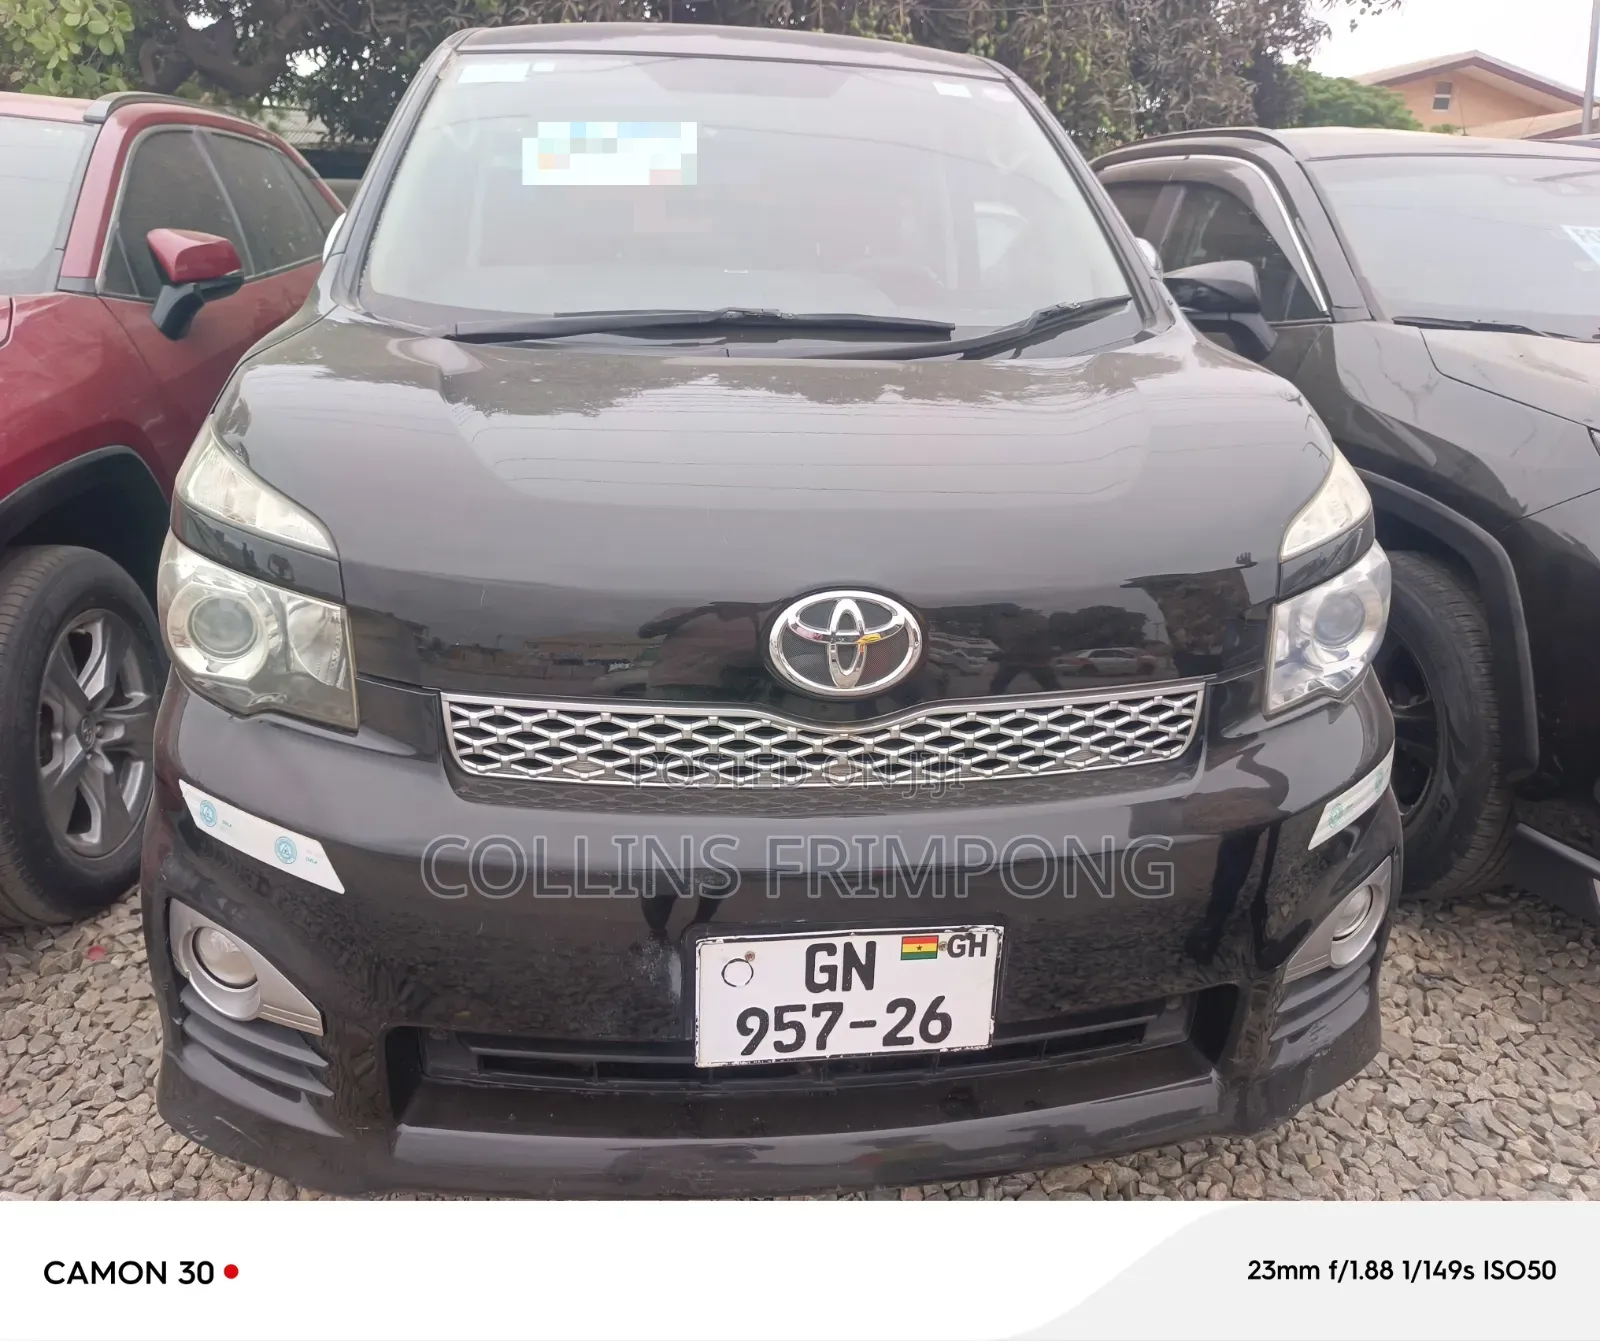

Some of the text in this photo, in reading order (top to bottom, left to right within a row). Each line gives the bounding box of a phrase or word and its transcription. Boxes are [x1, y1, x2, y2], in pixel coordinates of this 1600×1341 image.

[804, 933, 988, 993] GN GH
[736, 995, 952, 1056] 957-26
